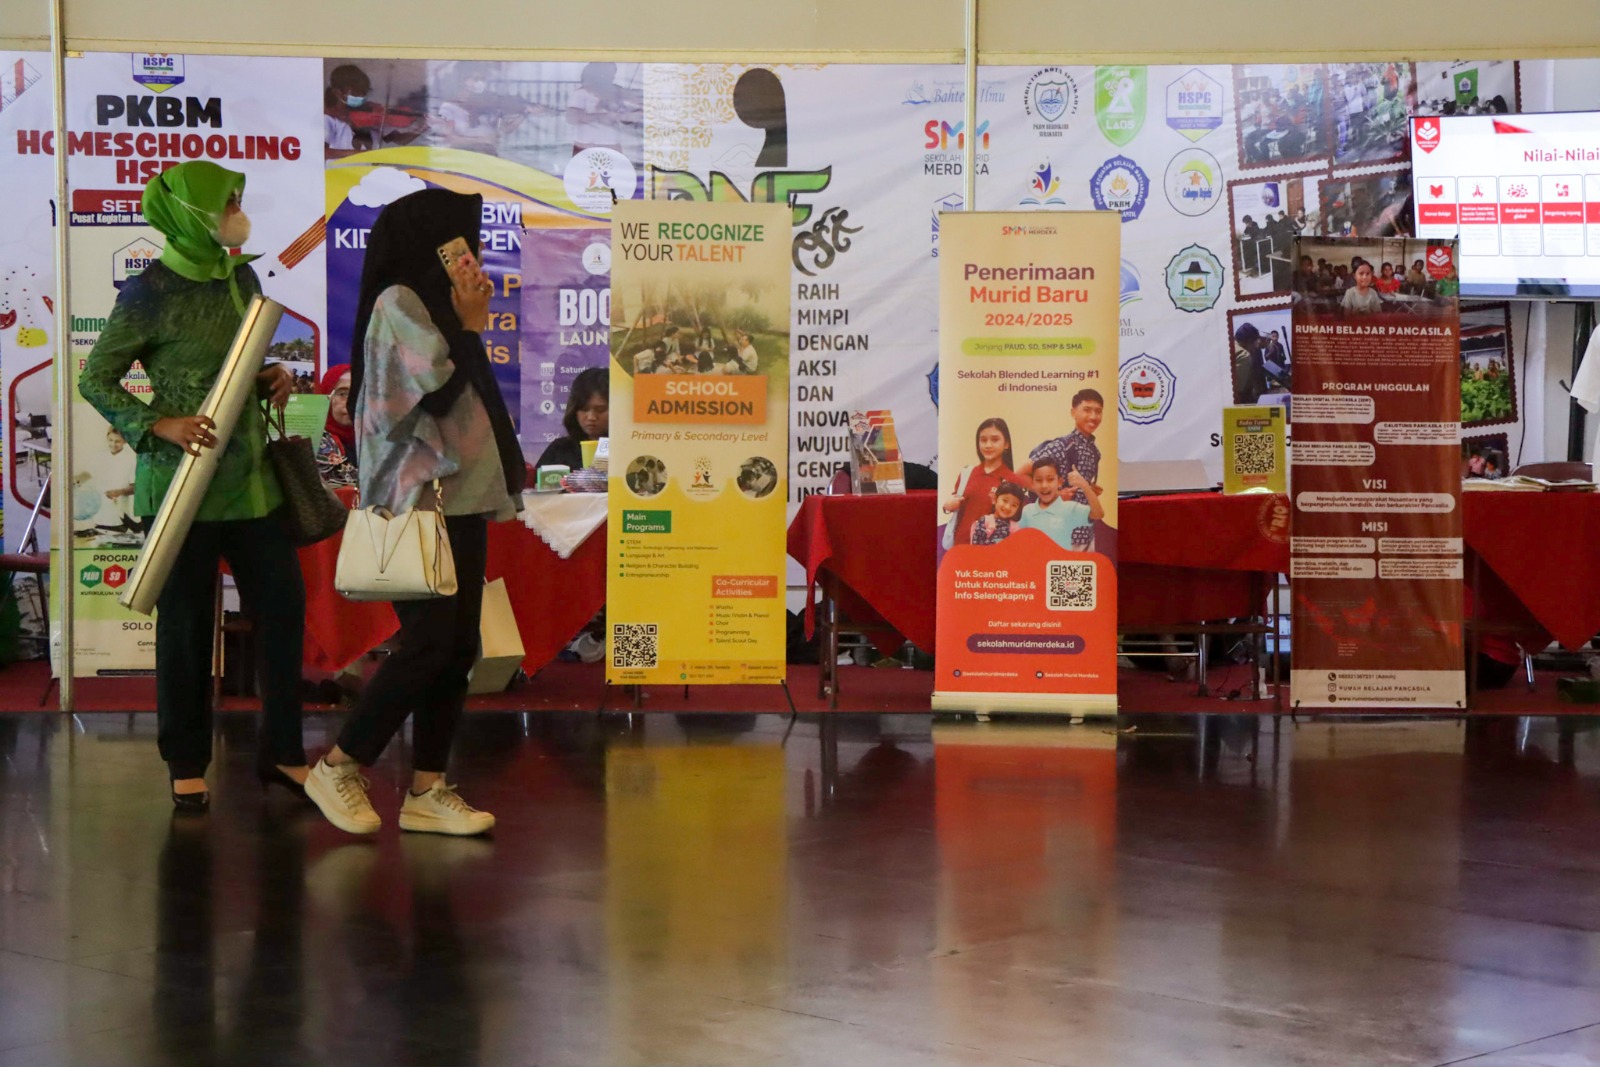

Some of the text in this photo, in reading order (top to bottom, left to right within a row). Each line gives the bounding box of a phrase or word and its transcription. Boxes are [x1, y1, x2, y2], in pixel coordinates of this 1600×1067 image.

[143, 57, 174, 67] HSPG
[934, 88, 966, 103] Bahte
[1178, 91, 1212, 104] HSPG
[96, 94, 223, 128] PKBM
[924, 154, 961, 162] SEKOLAH
[1523, 147, 1600, 162] Nilai-Nilai
[924, 163, 990, 176] MERDKA
[102, 199, 141, 213] SET
[1109, 200, 1131, 208] PKBM
[72, 213, 95, 223] Pusat
[96, 213, 131, 225] Kegiatan
[620, 222, 764, 242] WE RECOGNIZE
[621, 243, 746, 263] YOUR TALENT
[125, 258, 153, 269] HSP
[964, 263, 1095, 281] Penerimaan
[797, 283, 840, 301] RAIH
[970, 285, 1088, 303] Murid Baru
[797, 309, 849, 326] MIMPI
[984, 312, 1073, 327] 2024/2025
[1295, 324, 1452, 336] RUMAH BELAJAR PANCASILA
[560, 332, 608, 346] LAUN
[797, 334, 869, 351] DENGAN
[797, 359, 837, 376] AKSI
[957, 370, 1099, 382] Sekolah Blended Learning #1
[665, 381, 738, 396] SCHOOL
[998, 383, 1058, 392] di Indonesia
[1322, 382, 1430, 392] PROGRAM UNGGULAN
[797, 385, 834, 402] DAN
[647, 400, 753, 415] ADMISSION
[797, 410, 850, 427] INOVA
[631, 430, 768, 443] Primary & Secondary Level
[1362, 479, 1387, 489] VISI
[627, 513, 646, 521] Main
[626, 523, 665, 532] Programs
[1361, 522, 1388, 532] MISI
[82, 571, 121, 581] PAUD SD
[955, 570, 1008, 579] Yuk Scan QR
[715, 578, 770, 586] Co-Curricular
[955, 581, 981, 589] Untuk
[983, 581, 1029, 589] Konsultasi
[715, 588, 752, 596] Activities
[955, 592, 1034, 602] Info Selengkapnya
[122, 621, 153, 631] SOLO
[988, 620, 1010, 628] Daftar
[1010, 621, 1041, 629] sekarang
[977, 640, 1075, 649] sekolahmuridmerdeka.id
